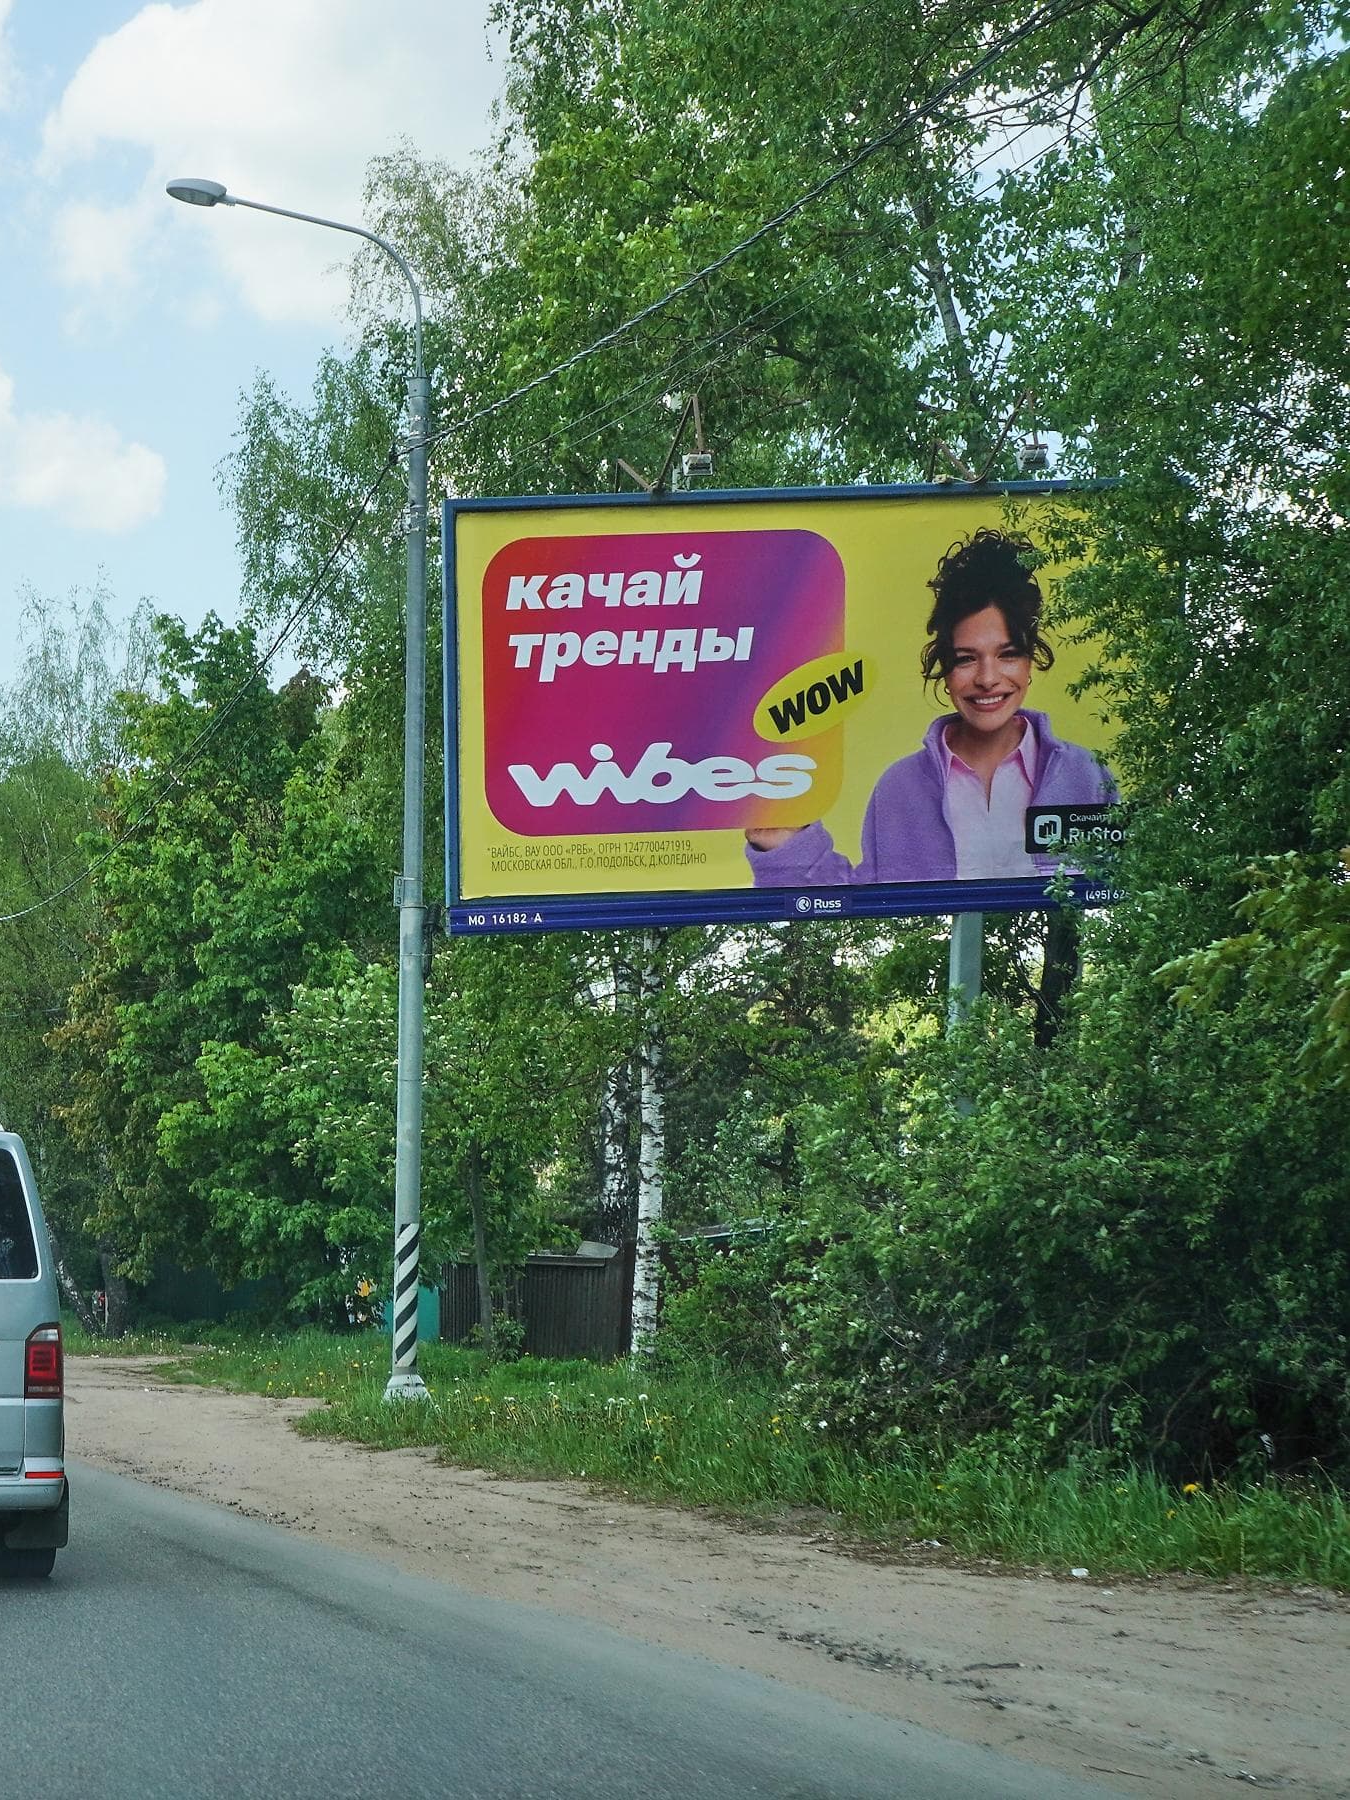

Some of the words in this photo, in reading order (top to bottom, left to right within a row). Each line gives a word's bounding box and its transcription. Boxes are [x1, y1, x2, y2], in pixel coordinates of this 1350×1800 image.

[505, 552, 703, 610] качай
[508, 626, 755, 683] тренды
[507, 742, 818, 807] wibes
[1070, 813, 1111, 822] Скачайт
[1069, 827, 1128, 843] RuStor
[526, 845, 541, 857] ВАУ
[543, 844, 563, 856] ООО
[598, 842, 621, 854] ОГРН
[491, 859, 551, 872] МОСКОВСКАЯ
[813, 898, 842, 909] Russ
[468, 915, 485, 926] МО
[492, 912, 527, 925] 16182
